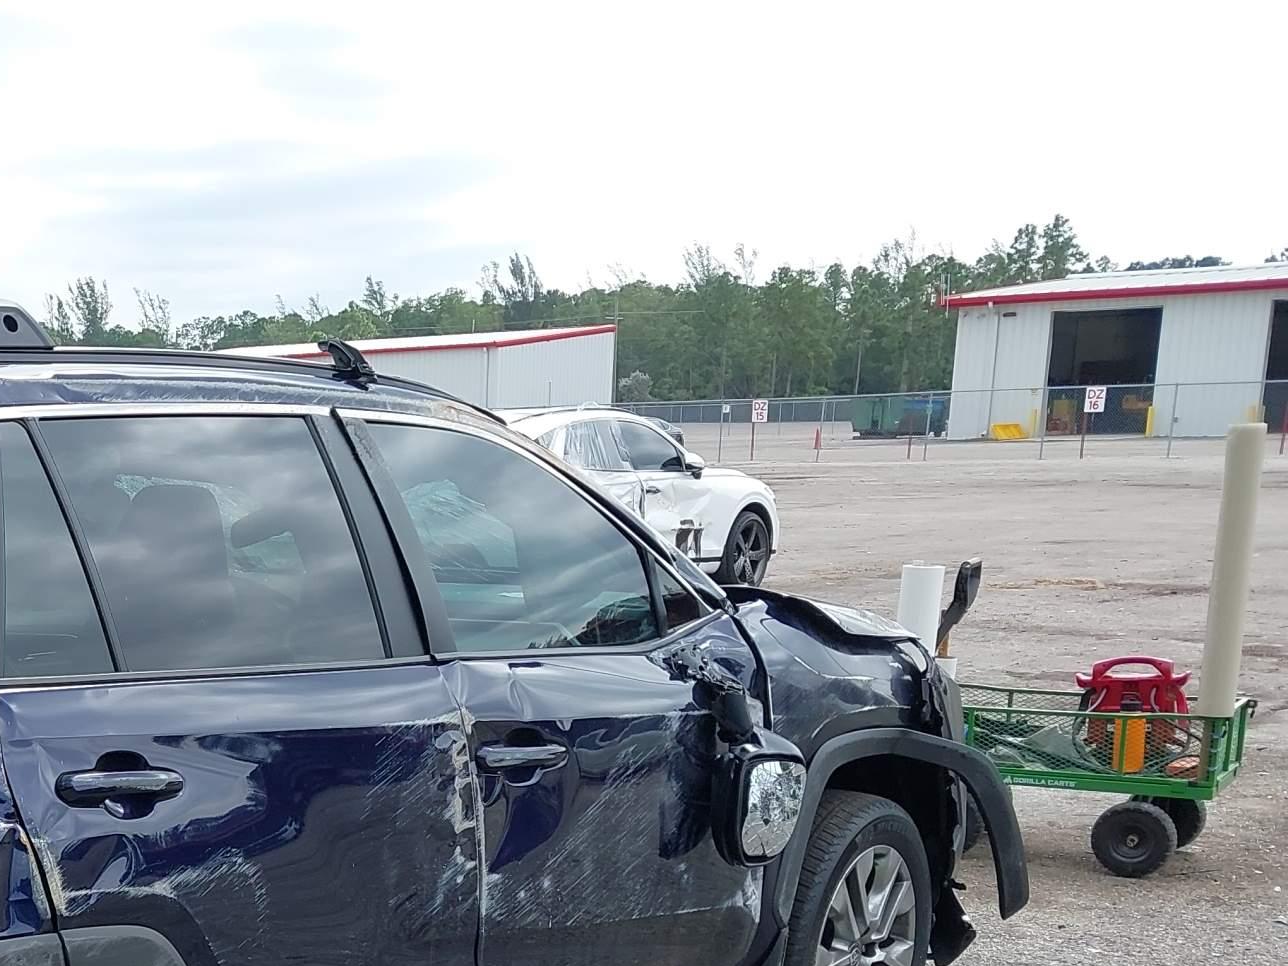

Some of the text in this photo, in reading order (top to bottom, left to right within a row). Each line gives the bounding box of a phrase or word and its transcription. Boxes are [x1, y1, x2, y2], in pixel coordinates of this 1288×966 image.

[1087, 389, 1104, 399] DZ
[754, 402, 767, 411] DZ
[1089, 401, 1099, 410] 16
[756, 412, 765, 421] 15
